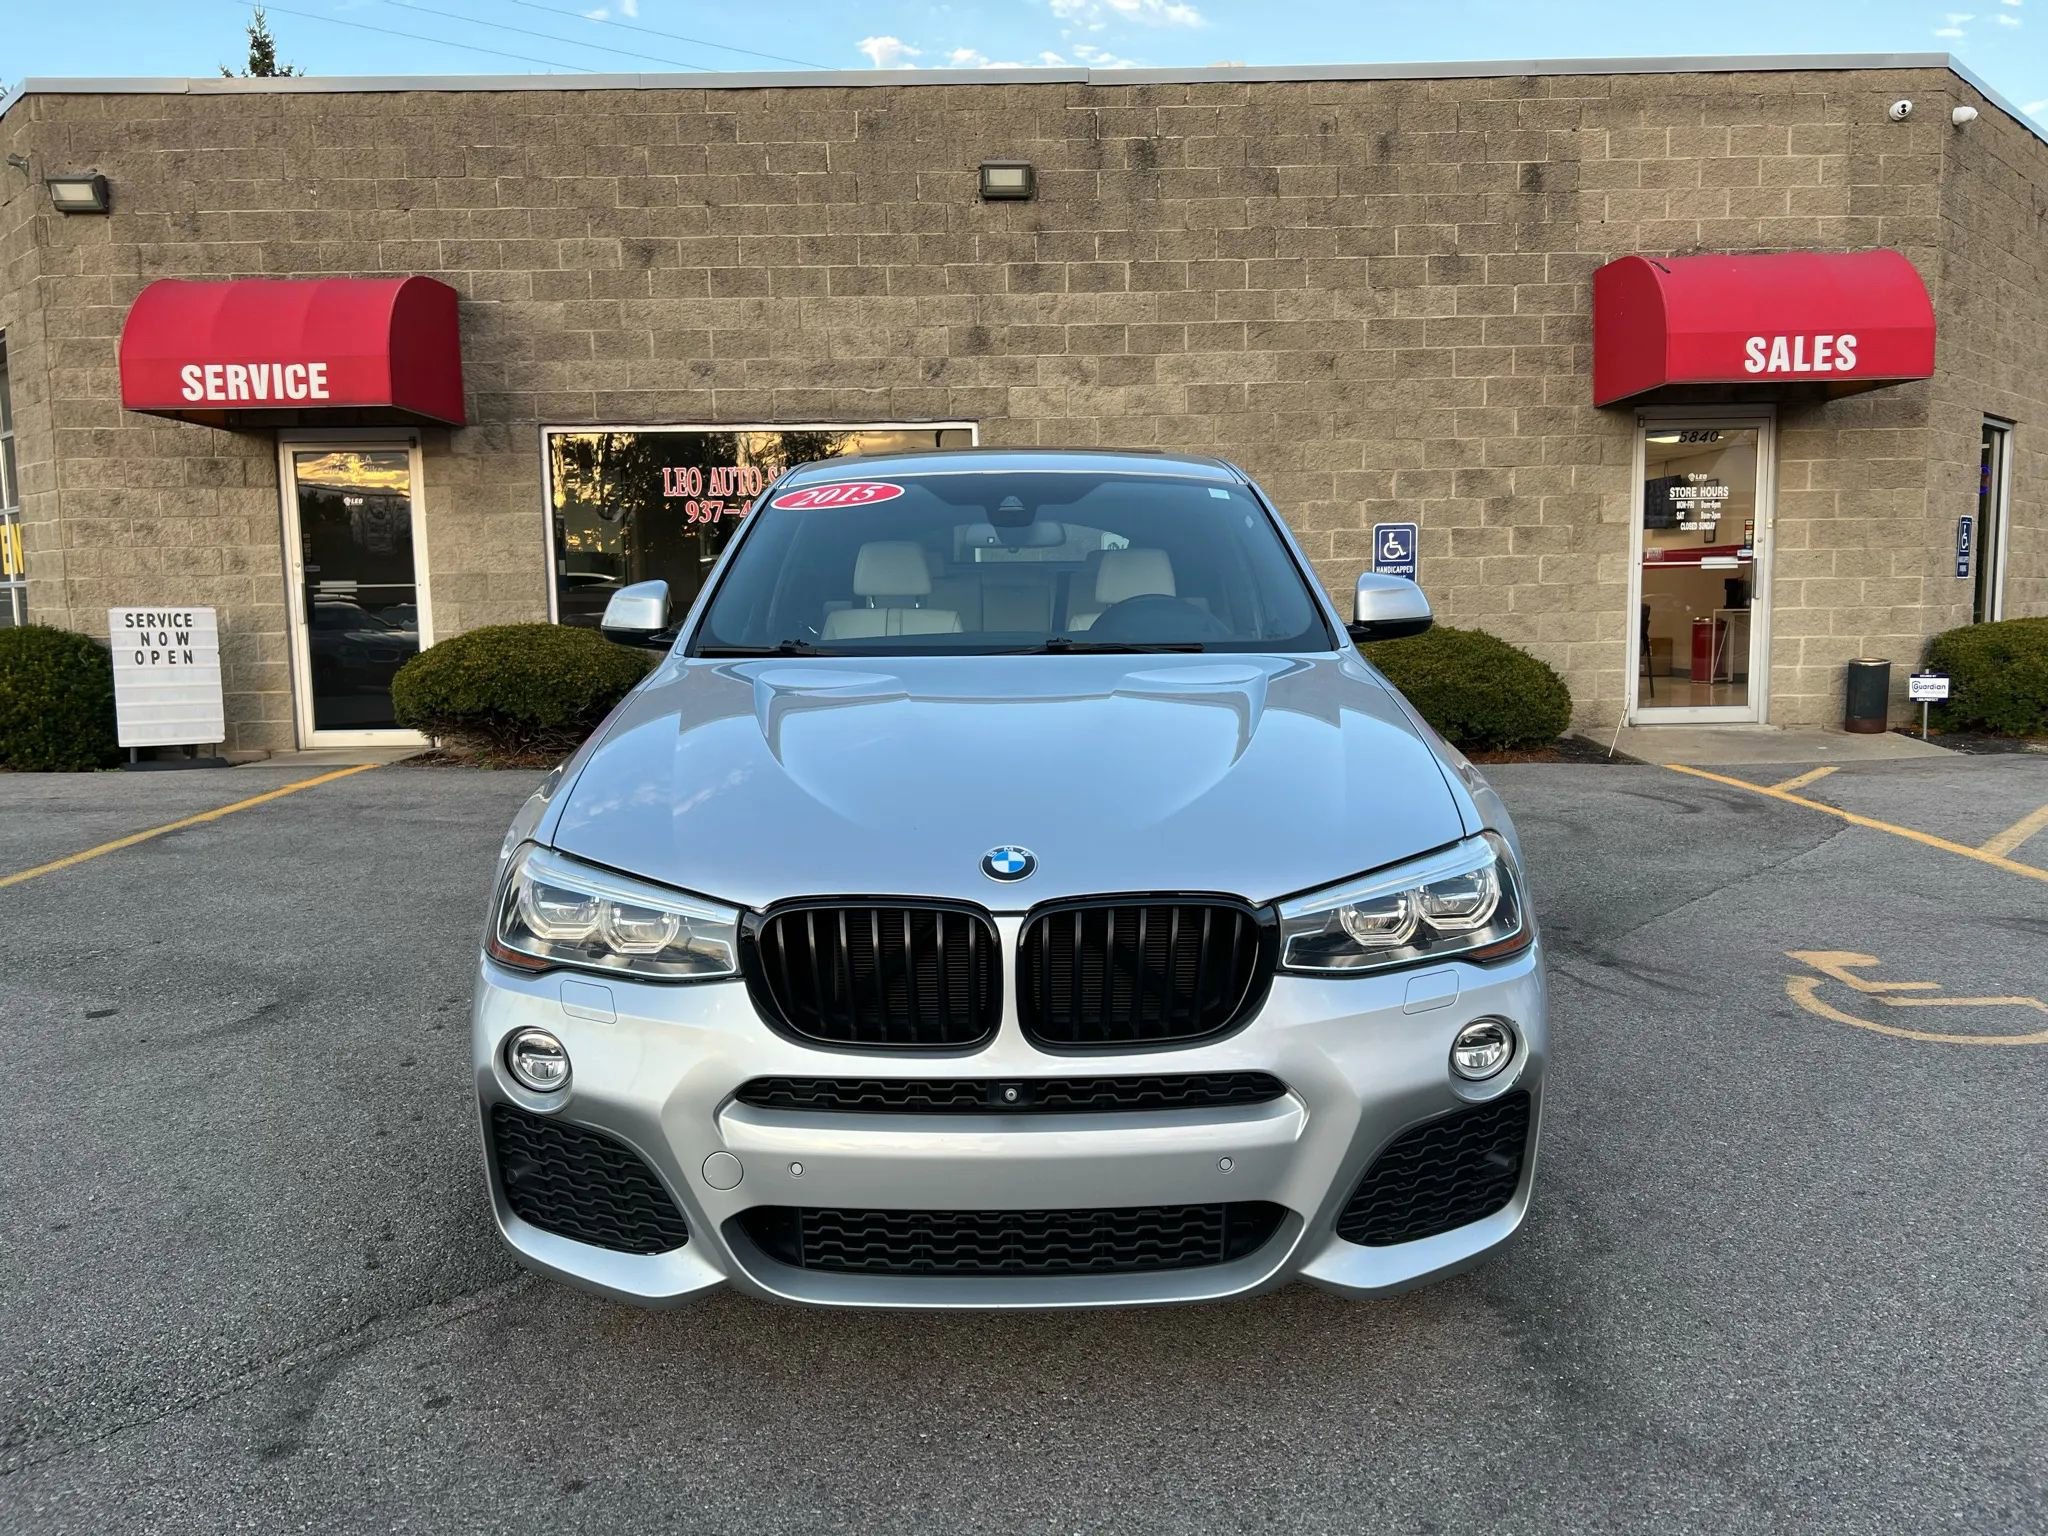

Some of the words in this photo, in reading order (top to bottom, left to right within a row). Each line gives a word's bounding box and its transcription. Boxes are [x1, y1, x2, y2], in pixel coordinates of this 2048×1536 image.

[1744, 333, 1857, 374] SALES
[181, 362, 330, 402] SERVICE
[1678, 430, 1720, 443] 5840
[662, 467, 702, 497] LEO
[707, 466, 762, 497] AUTO
[792, 486, 880, 507] 2015
[1669, 487, 1697, 498] STORE
[1699, 486, 1729, 498] HOURS
[1676, 511, 1685, 520] SAT
[1680, 522, 1697, 531] CLOSED
[1698, 521, 1716, 530] SUNDAY
[1375, 565, 1414, 574] HANDICAPPED
[125, 613, 193, 628] SERVICE
[140, 631, 190, 647] NOW
[134, 650, 194, 665] OPEN
